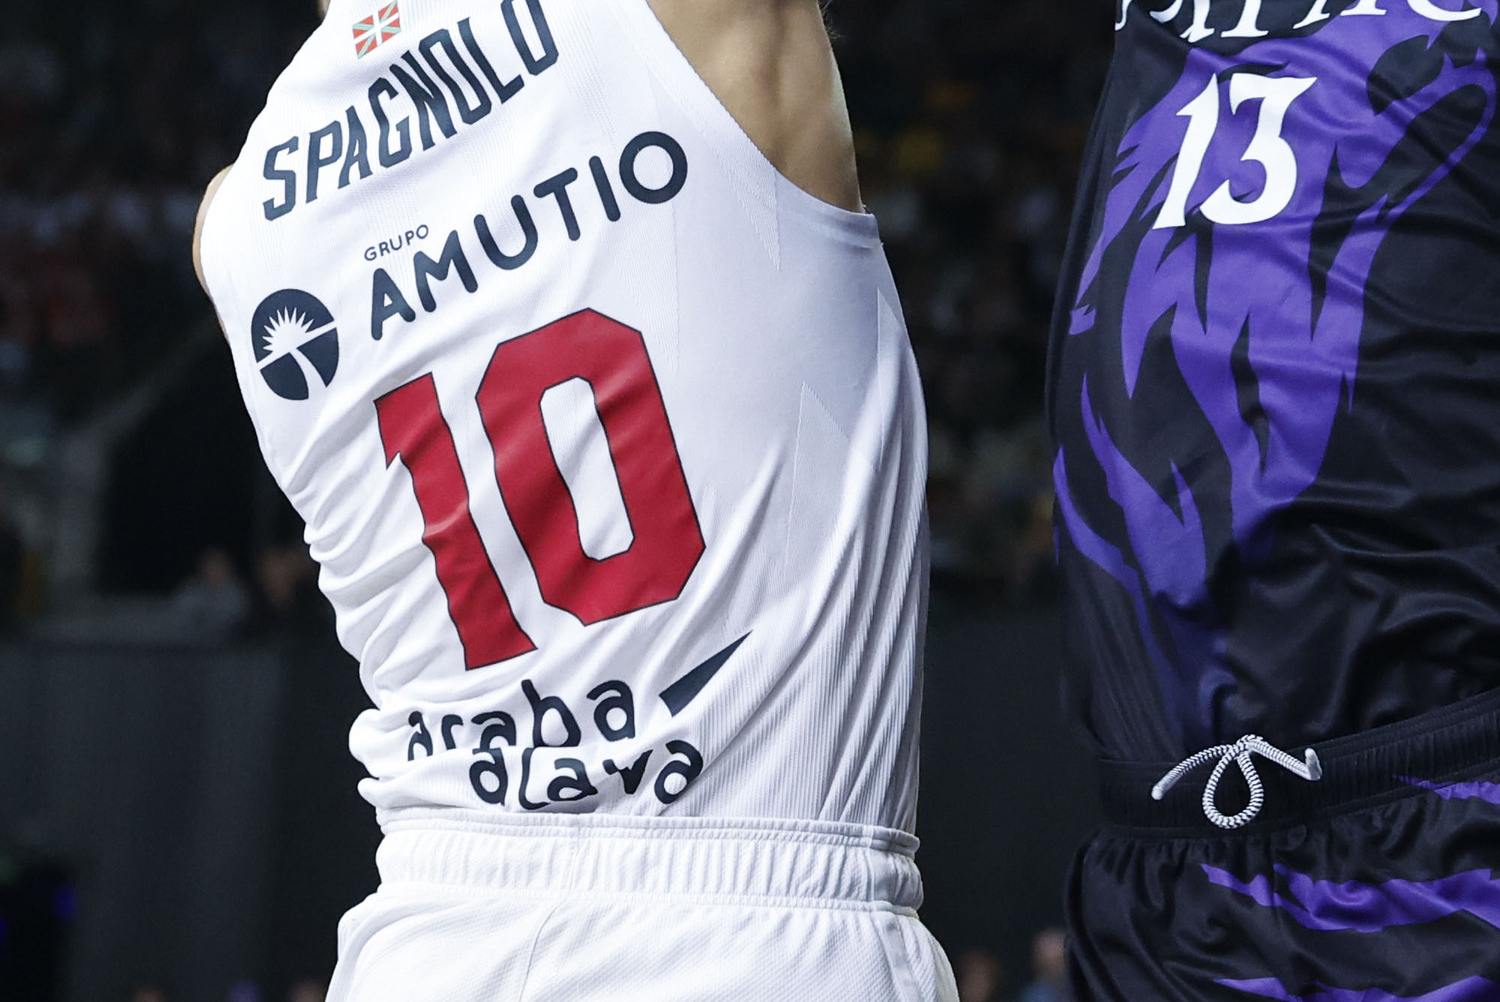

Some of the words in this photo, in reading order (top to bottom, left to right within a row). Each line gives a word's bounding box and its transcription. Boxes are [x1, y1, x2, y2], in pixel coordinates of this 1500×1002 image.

[363, 224, 430, 262] GRUPO
[370, 130, 689, 342] AMUTIO
[1152, 72, 1318, 230] 13
[372, 306, 707, 672] 10
